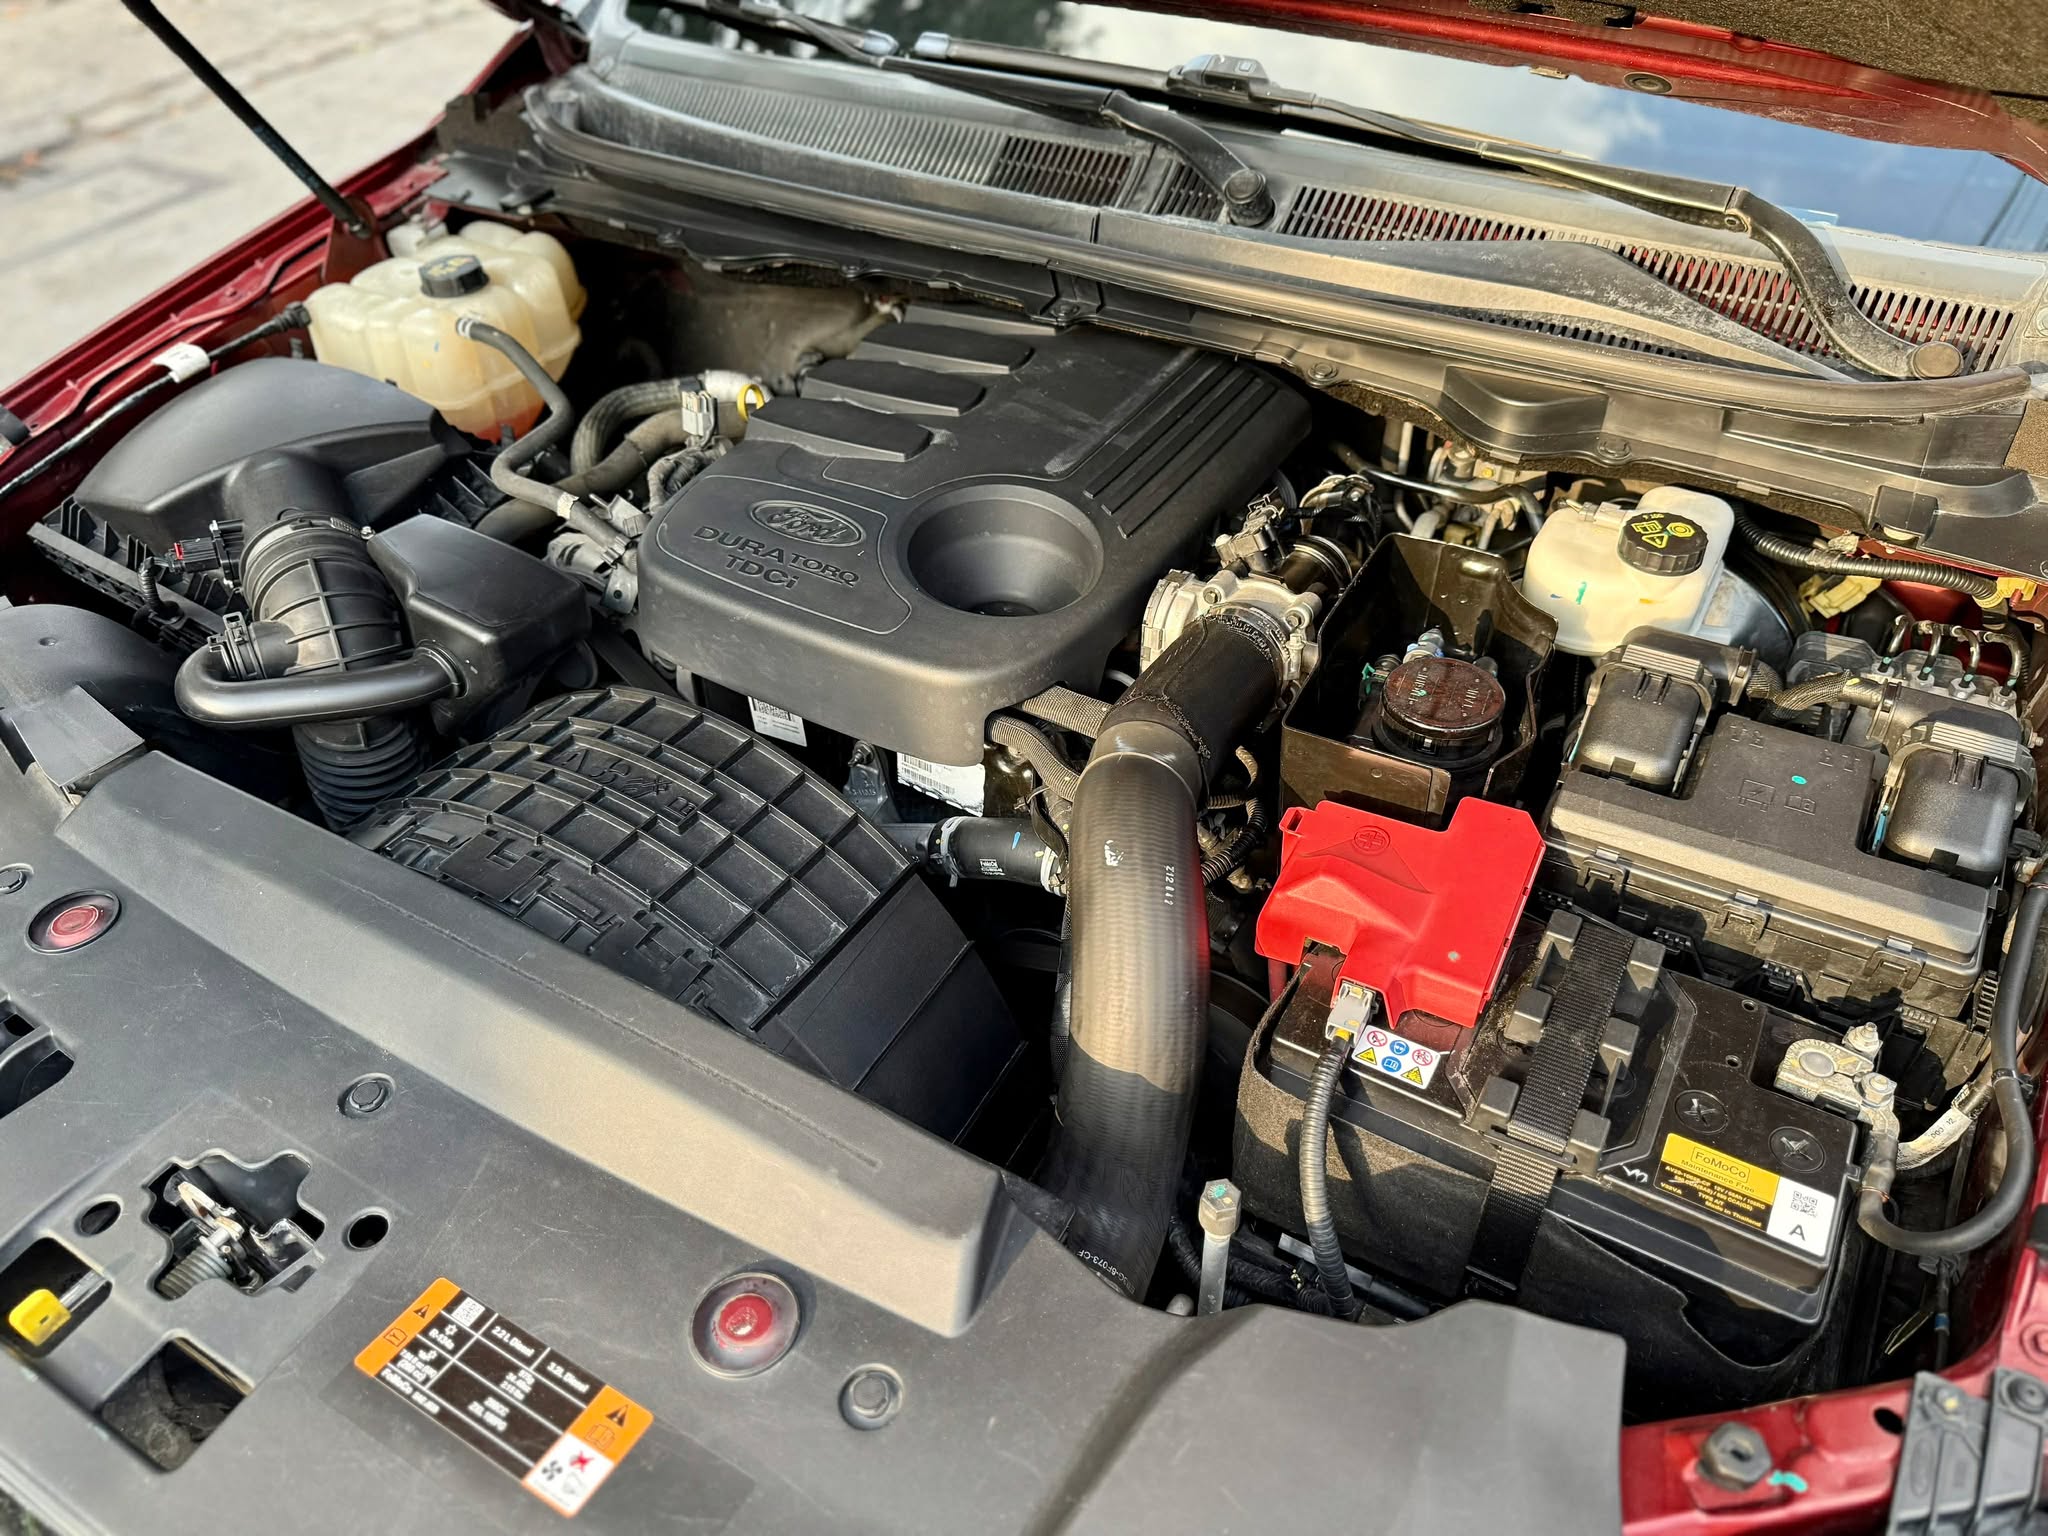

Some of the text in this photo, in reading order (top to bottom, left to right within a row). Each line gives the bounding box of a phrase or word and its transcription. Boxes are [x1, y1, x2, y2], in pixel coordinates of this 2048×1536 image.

[766, 507, 847, 543] Ford
[725, 554, 799, 589] TDCi
[1681, 1159, 1755, 1193] Maintenance Free
[1695, 1150, 1747, 1179] FoMoCo
[1733, 1211, 1762, 1227] Thailand
[1788, 1224, 1806, 1241] A
